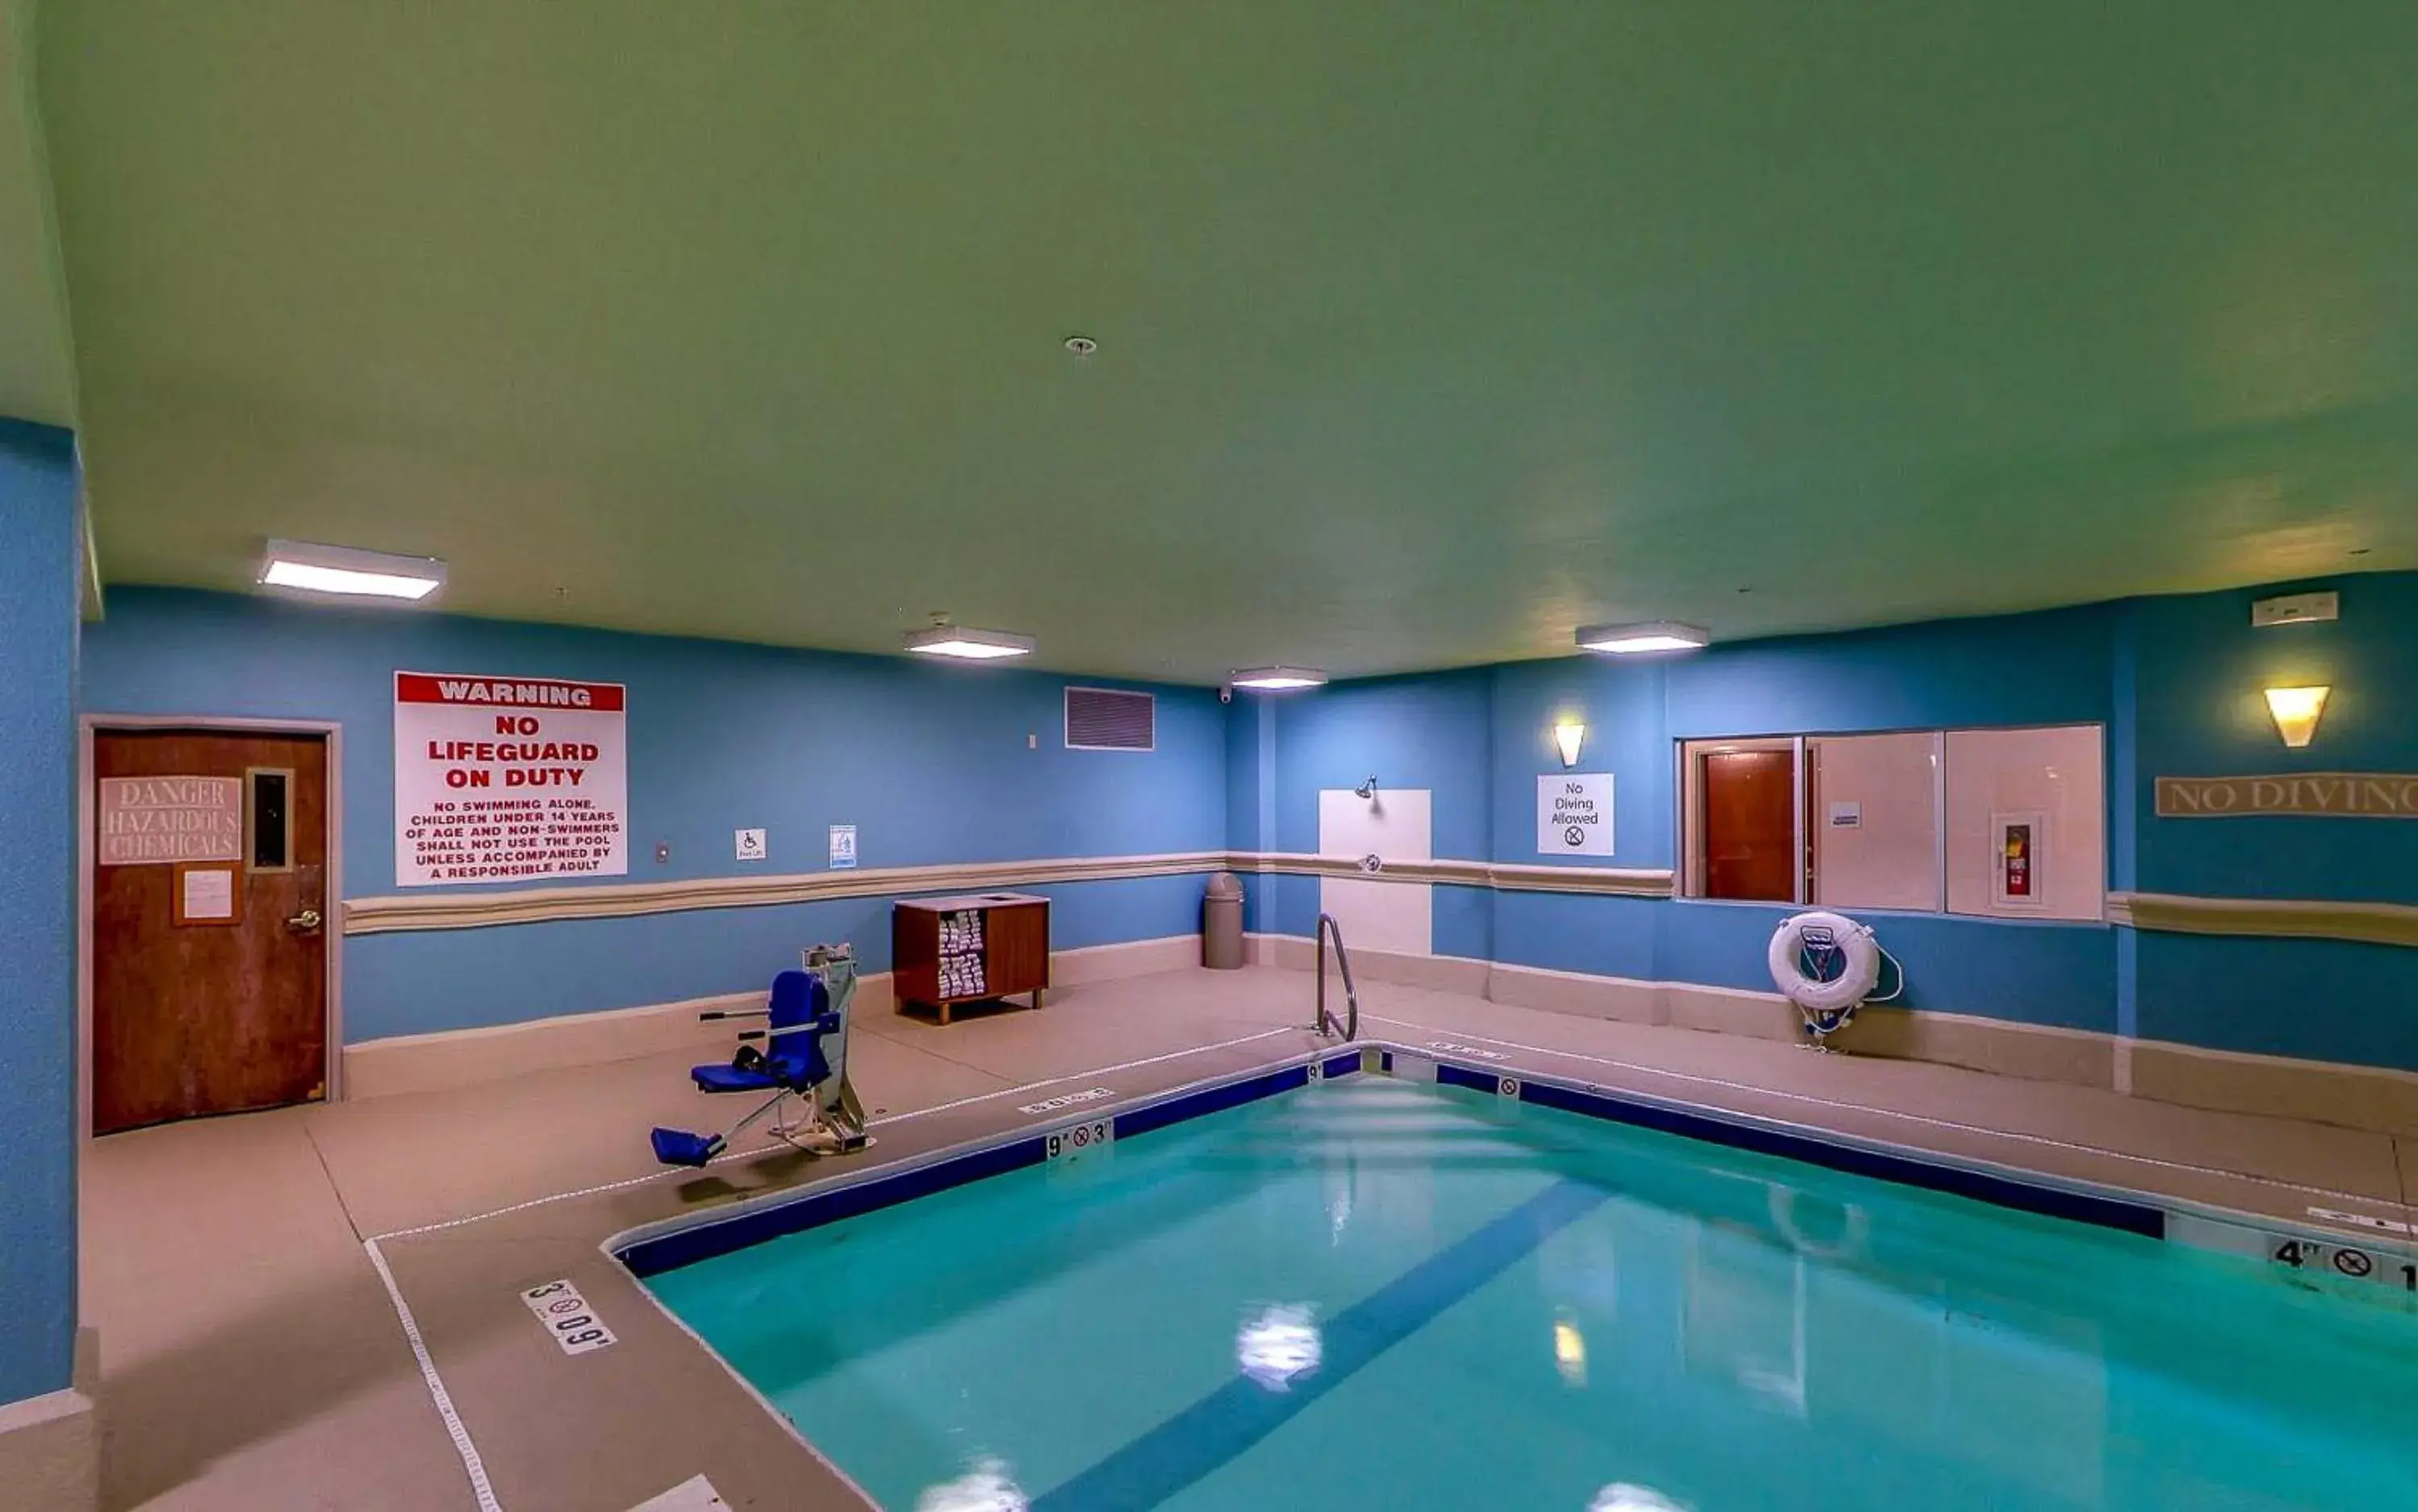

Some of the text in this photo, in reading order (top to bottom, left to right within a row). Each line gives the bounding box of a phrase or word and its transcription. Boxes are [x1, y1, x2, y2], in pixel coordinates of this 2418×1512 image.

[437, 681, 592, 706] WARNING
[496, 716, 539, 735] NO
[428, 741, 599, 762] LIFEGUARD
[446, 768, 584, 788] ON DUTY
[121, 782, 225, 805] DANGER
[1565, 783, 1583, 794] No
[2170, 783, 2237, 810] NO
[434, 802, 455, 812] NO
[463, 800, 541, 811] SWIMMING
[1555, 798, 1593, 812] Diving
[109, 810, 235, 835] HAZARDOUS
[411, 812, 615, 826] CHILDREN UNDER 14 YEARS
[1552, 812, 1598, 825] Allowed
[405, 824, 619, 839] OF AGE AND NON-SWIMMERS
[110, 835, 233, 858] CHEMICALS
[417, 836, 610, 851] SHALL NOT USE THE POOL
[416, 848, 611, 866] UNLESS ACCOMPANIED BY
[430, 860, 600, 879] A RESPONSIBLE ADULT
